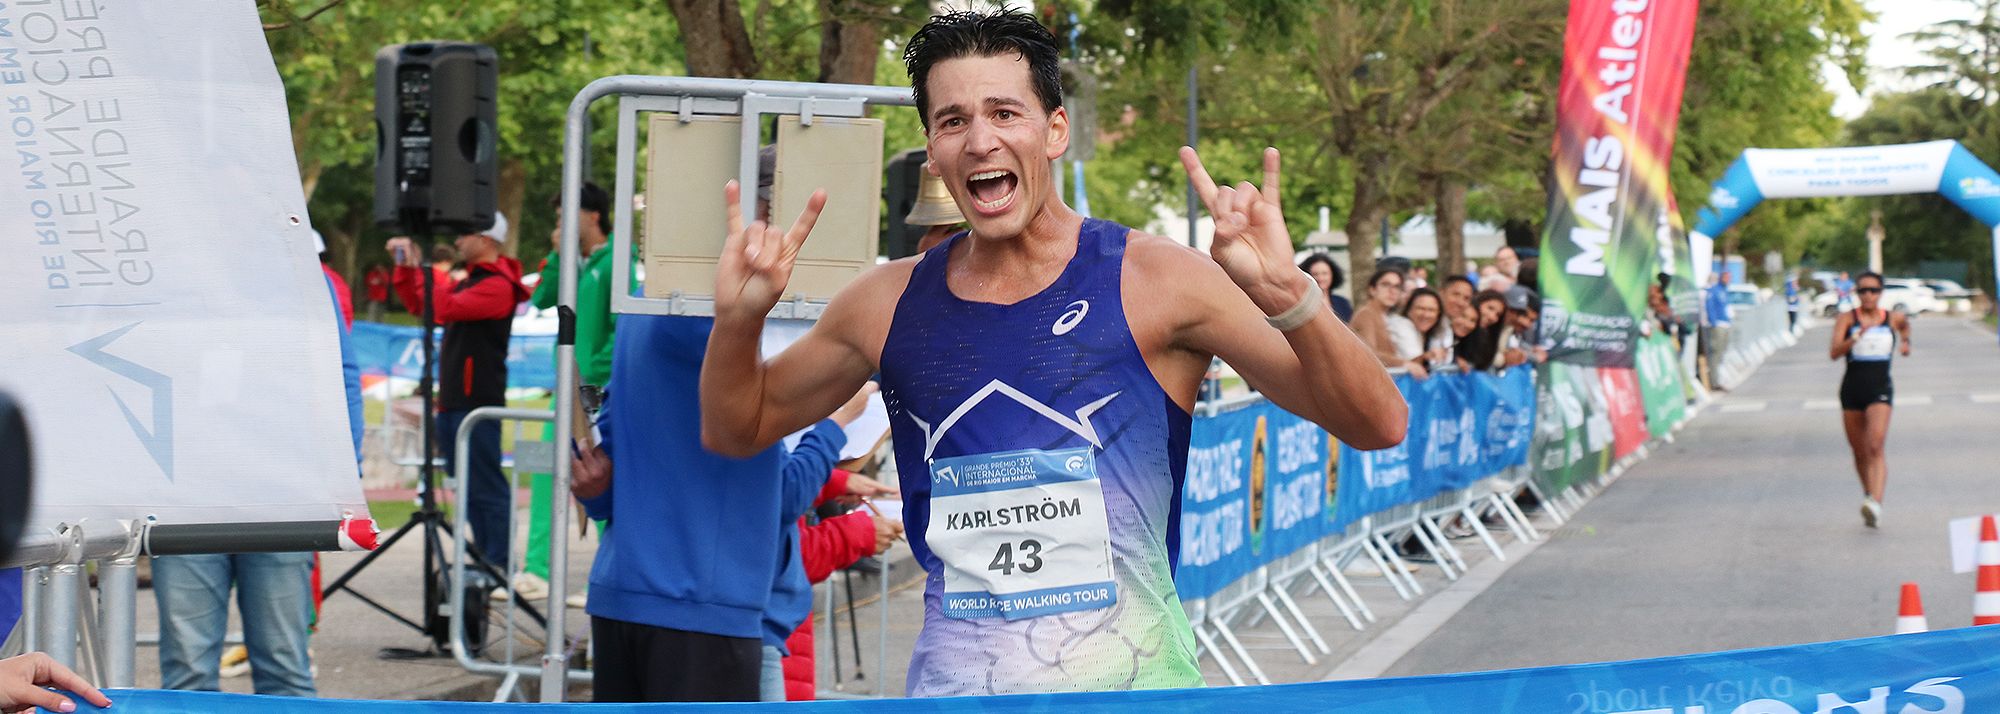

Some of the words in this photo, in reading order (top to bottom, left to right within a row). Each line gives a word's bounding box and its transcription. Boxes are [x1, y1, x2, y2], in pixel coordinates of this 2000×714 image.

[1565, 135, 1623, 276] MAIS
[965, 464, 990, 472] GRANDE
[966, 466, 1036, 480] INTERNACIONAL
[1012, 474, 1037, 482] MARCHA
[946, 497, 1082, 531] KARLSTRÖM
[988, 539, 1043, 576] 43
[949, 598, 987, 611] WORLD
[989, 597, 1012, 612] RCE
[1014, 592, 1072, 611] WALKING
[1073, 588, 1109, 603] TOUR
